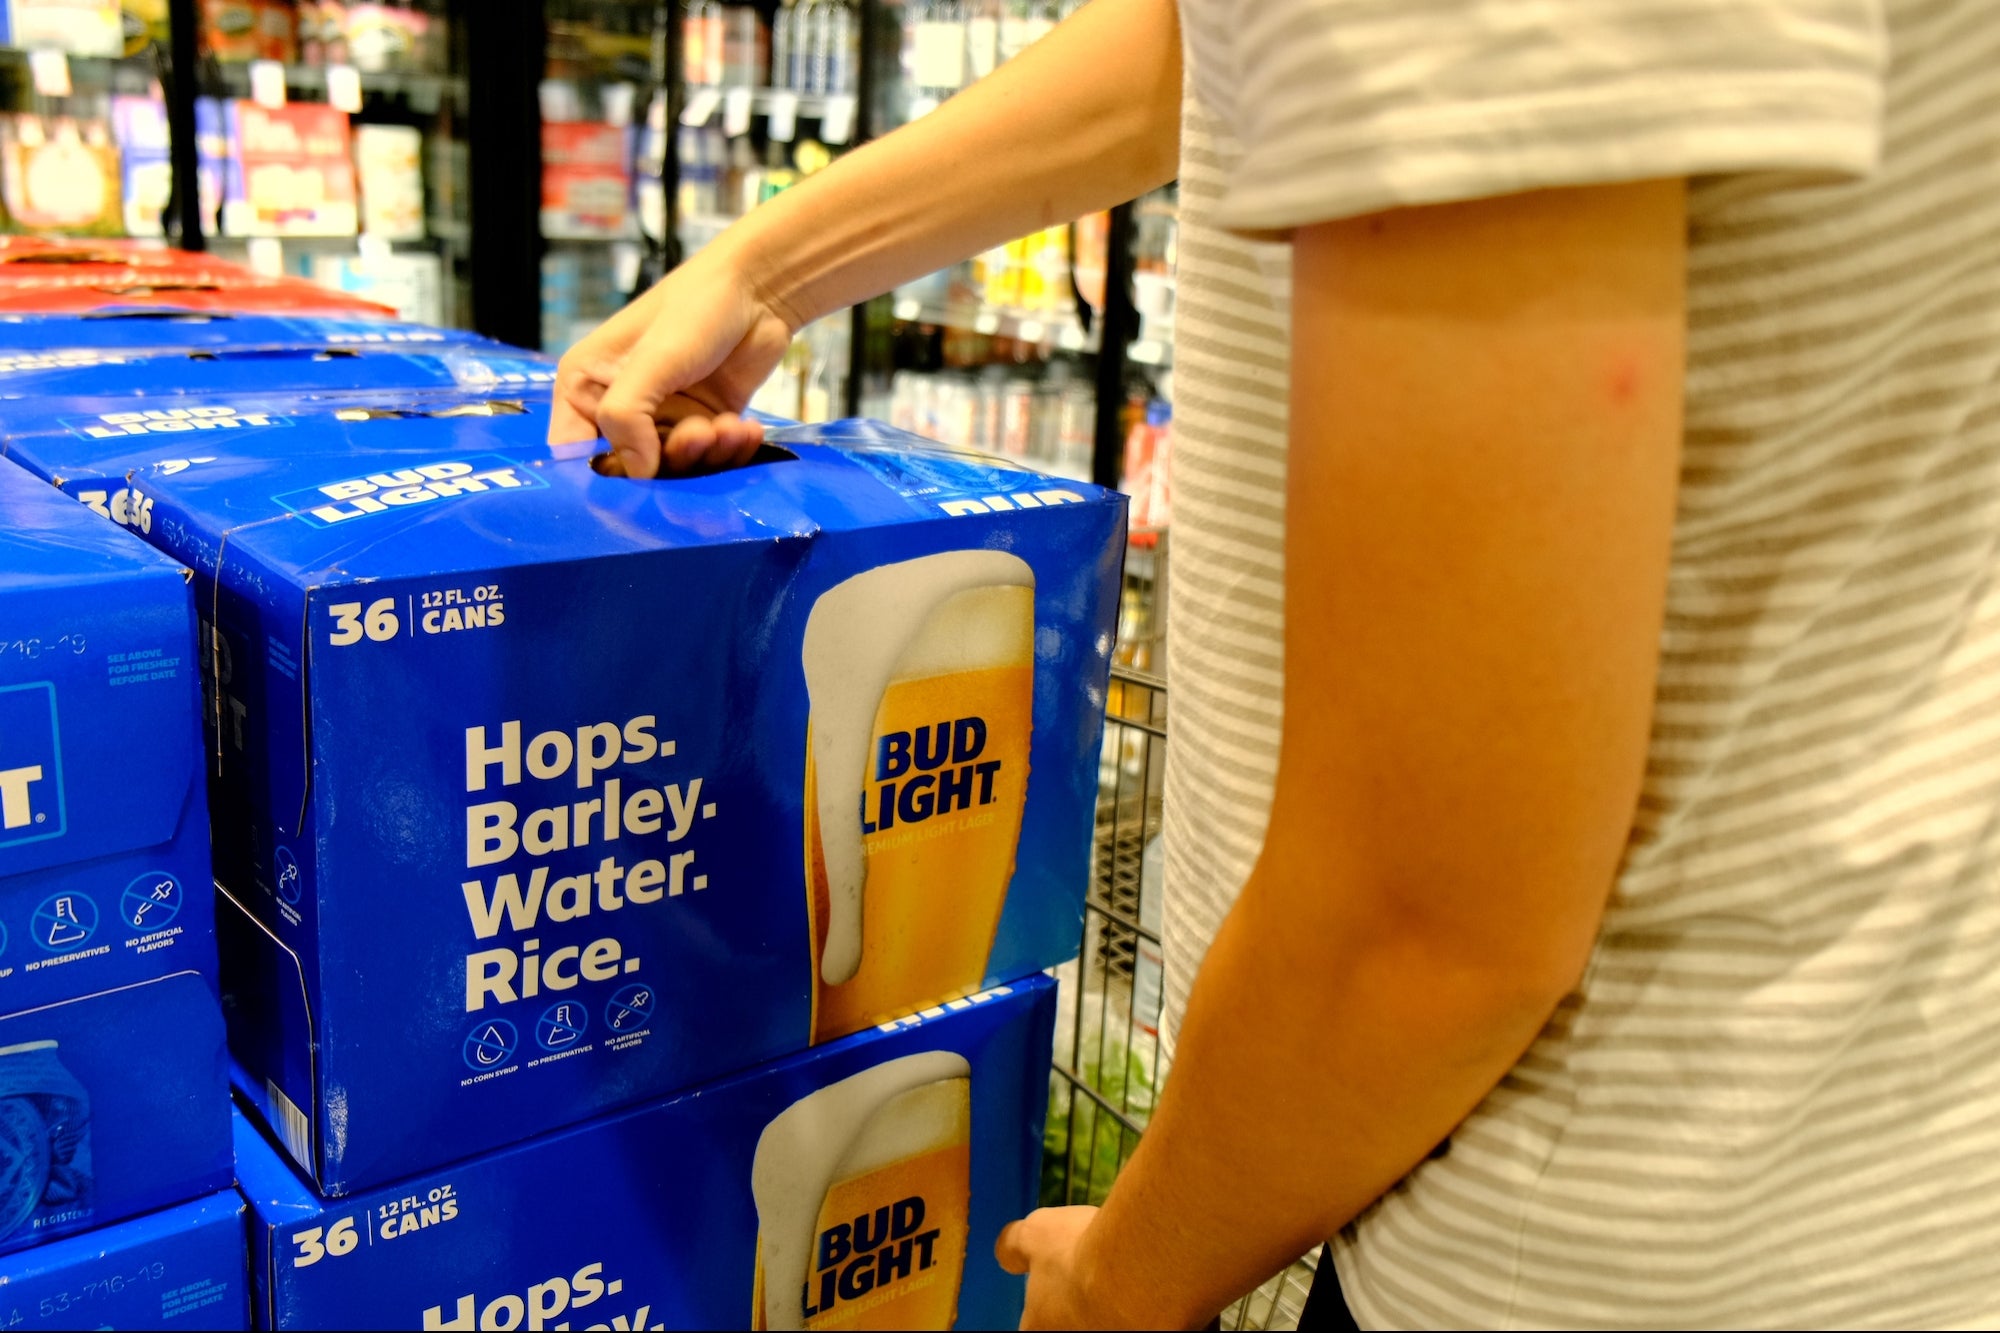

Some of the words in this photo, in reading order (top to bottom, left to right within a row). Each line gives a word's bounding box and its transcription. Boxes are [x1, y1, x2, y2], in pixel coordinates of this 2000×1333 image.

[84, 412, 272, 438] LIGHT
[100, 407, 237, 425] BUD
[318, 463, 473, 500] BUD
[310, 469, 522, 523] LIGHT
[328, 598, 400, 646] 36
[422, 603, 505, 635] CANS
[107, 654, 126, 664] SEE
[128, 649, 162, 661] ABOVE
[108, 665, 130, 675] FOR
[131, 657, 181, 672] FRESHEST
[109, 673, 149, 686] BEFORE
[151, 669, 177, 681] DATE
[465, 715, 676, 792] Hops.
[875, 717, 986, 782] BUD
[466, 777, 717, 868] Barley.
[917, 820, 956, 842] LIGHT
[959, 813, 996, 831] LAGER
[461, 850, 708, 940] Water.
[125, 938, 139, 948] NO
[140, 927, 183, 945] ARTIFICIAL
[137, 938, 174, 954] FLAVORS
[25, 962, 40, 972] NO
[41, 945, 111, 968] PRESERVATIVES
[465, 937, 641, 1012] Rice.
[604, 1038, 616, 1047] NO
[616, 1029, 651, 1044] ARTIFICIAL
[612, 1038, 642, 1051] FLAVORS
[527, 1060, 539, 1068] NO
[540, 1045, 593, 1065] PRESERVATIVES
[461, 1077, 473, 1087] NO
[474, 1071, 495, 1084] CORN
[495, 1065, 519, 1078] SYRUP
[380, 1199, 459, 1240] CANS
[292, 1217, 359, 1268] 36
[818, 1197, 925, 1272] BUD
[161, 1289, 181, 1301] SEE
[181, 1278, 212, 1295] ABOVE
[162, 1299, 181, 1311] FOR
[183, 1283, 228, 1304] FRESHEST
[858, 1288, 899, 1314] LIGHT
[899, 1273, 936, 1296] LAGER
[162, 1302, 199, 1320] BEFORE
[199, 1293, 225, 1308] DATE
